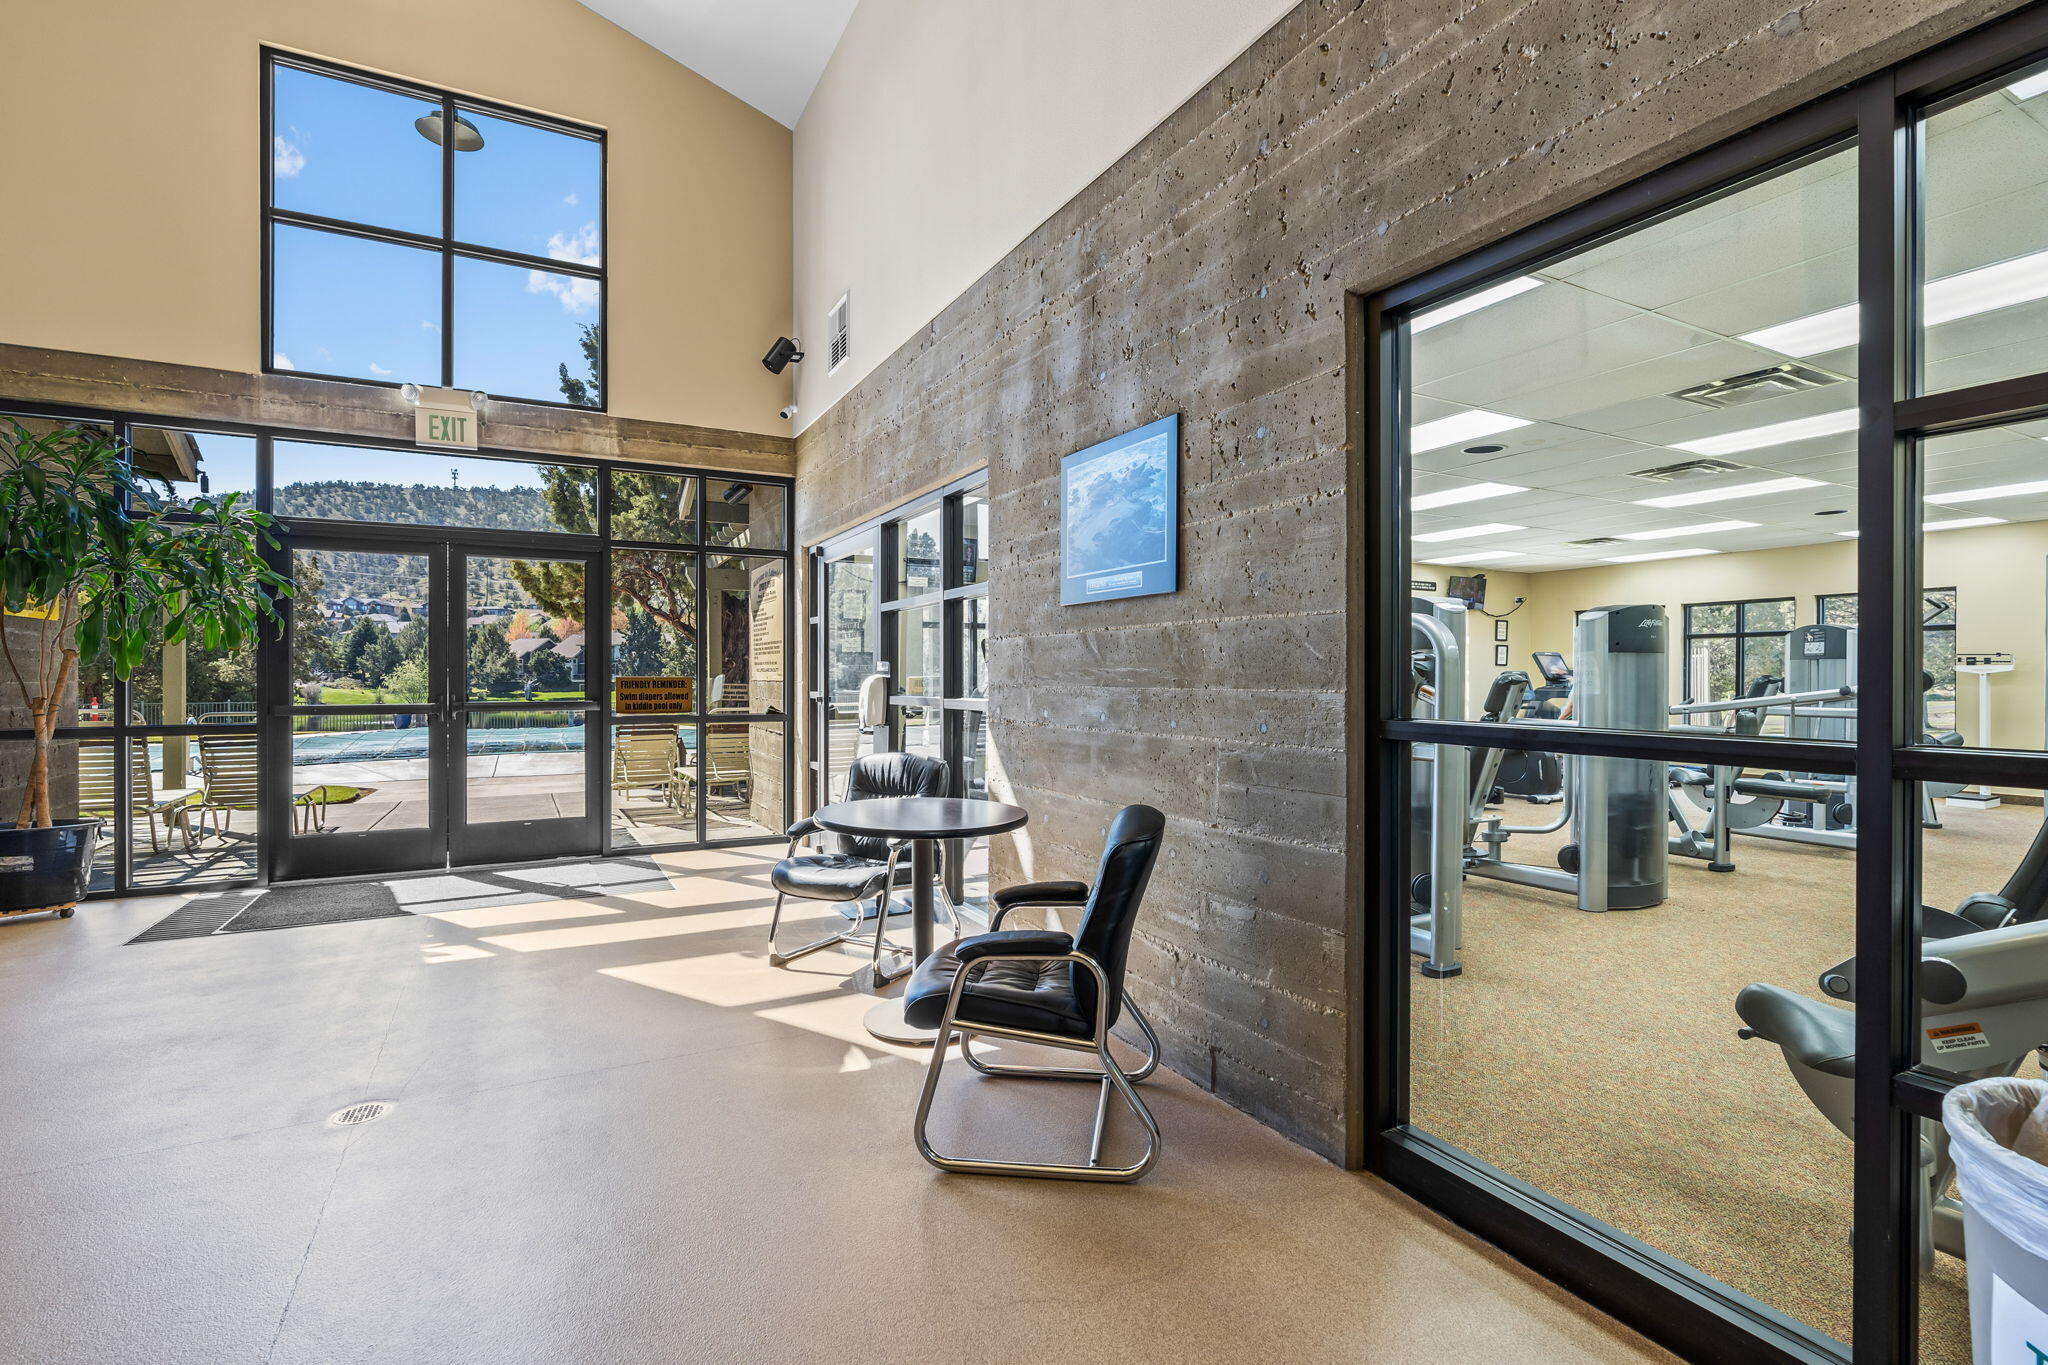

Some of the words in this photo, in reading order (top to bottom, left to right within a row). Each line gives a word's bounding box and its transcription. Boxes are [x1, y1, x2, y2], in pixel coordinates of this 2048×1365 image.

[429, 414, 467, 442] EXIT
[620, 680, 651, 689] FRIENDLY
[652, 680, 688, 689] REMINDER:
[619, 692, 637, 701] Swim
[638, 692, 663, 702] diapers
[664, 691, 689, 700] allowed
[632, 702, 653, 710] kiddie
[653, 701, 668, 710] pool
[668, 701, 683, 710] only
